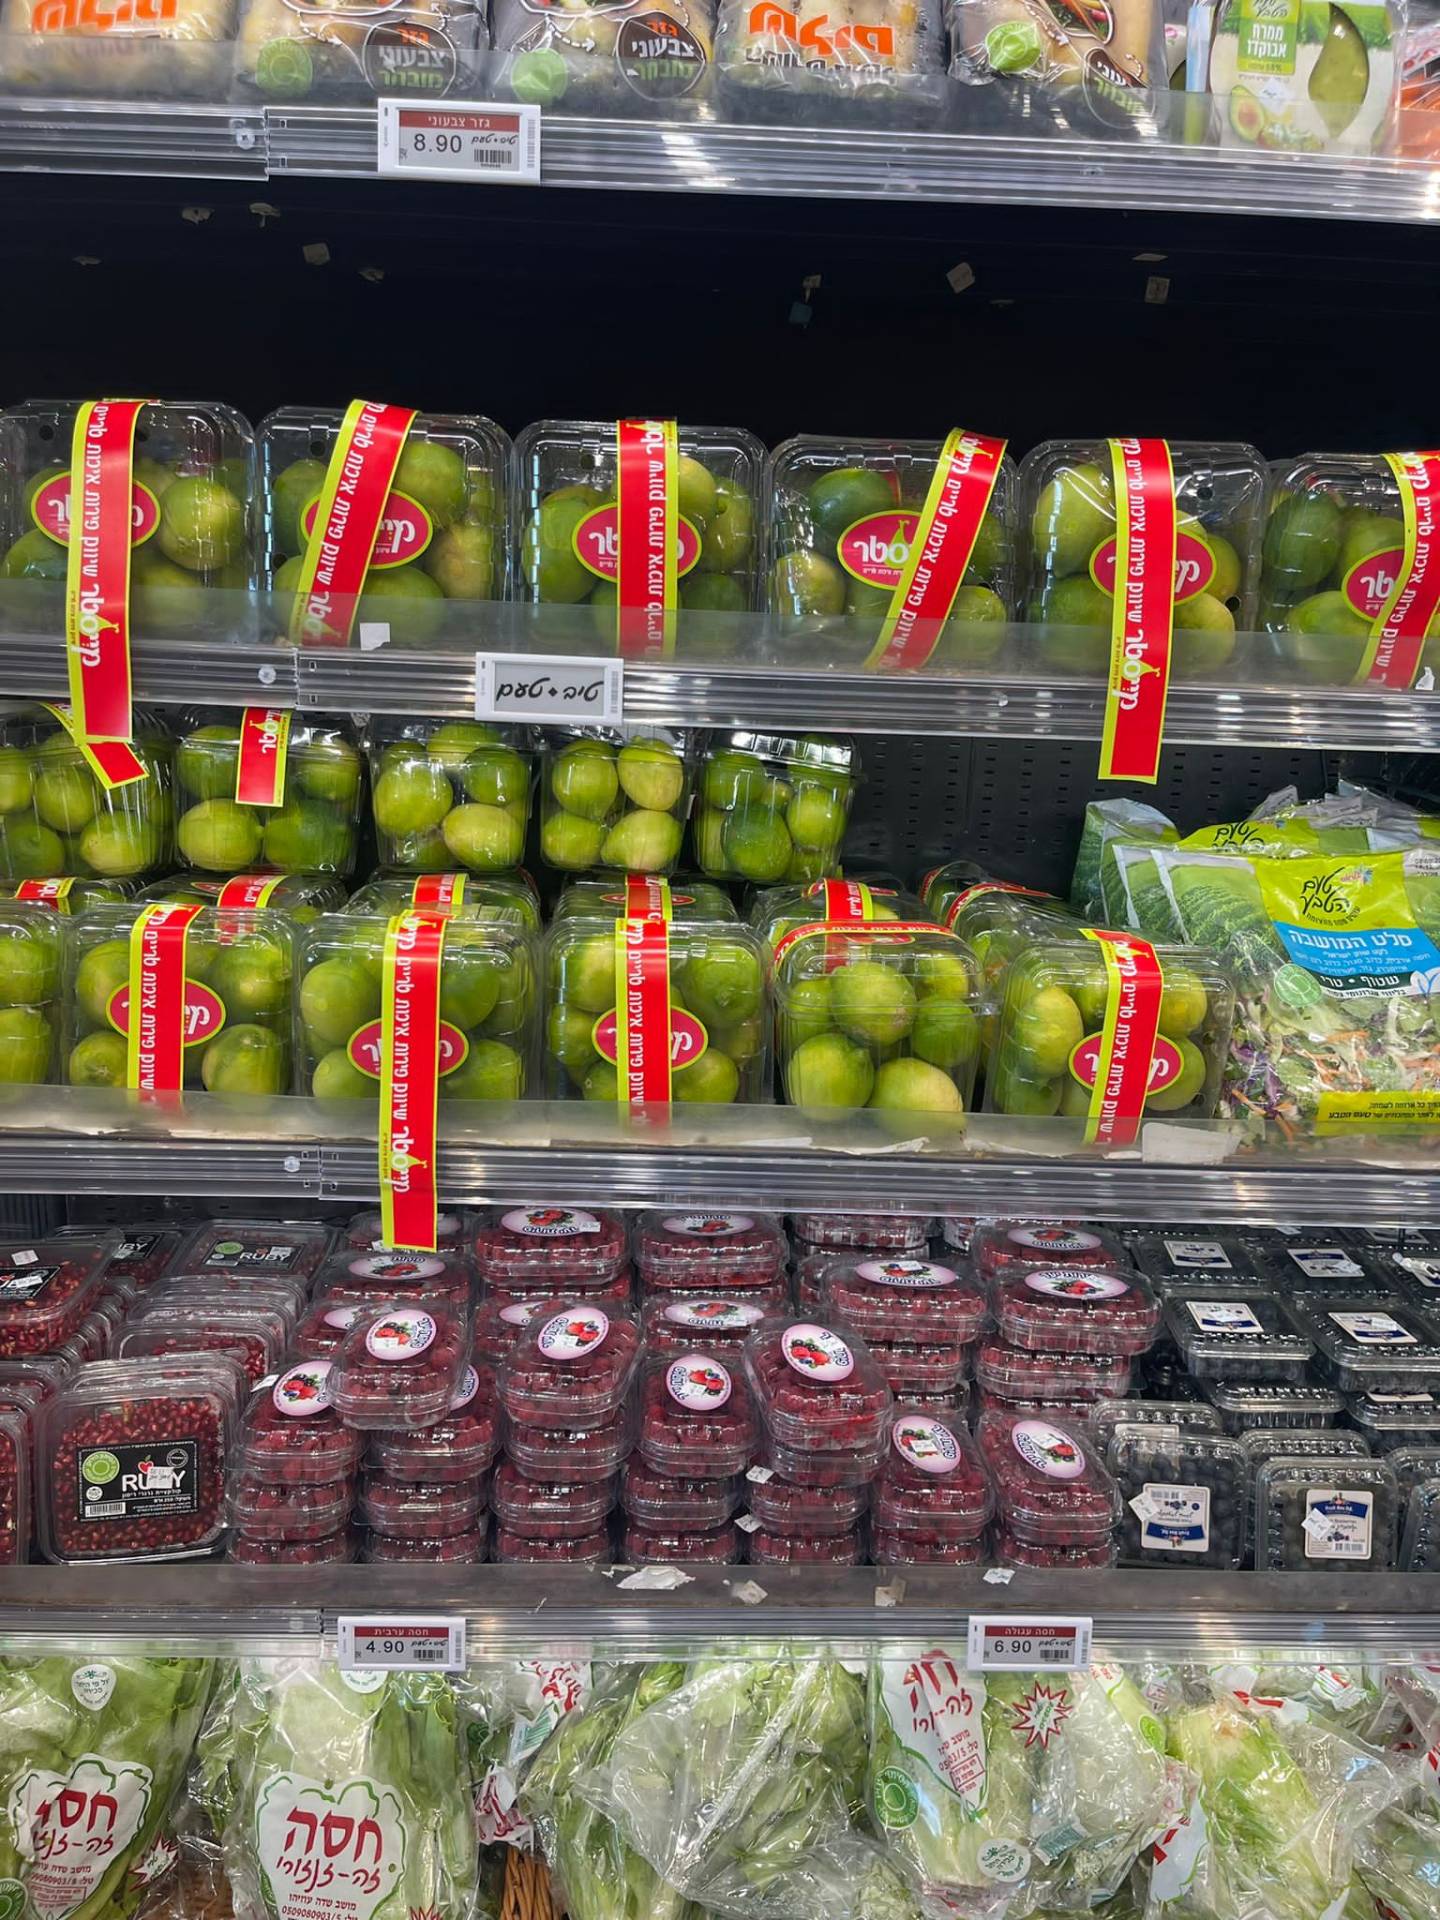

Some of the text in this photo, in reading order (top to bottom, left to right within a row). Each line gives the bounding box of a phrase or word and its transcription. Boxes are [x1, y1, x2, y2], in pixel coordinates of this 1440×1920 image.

[631, 37, 695, 58] צבעוני
[1247, 39, 1288, 58] אבוקדו
[427, 115, 491, 128] גזר צבעוני
[413, 133, 463, 153] 8.90
[88, 403, 109, 440] טריים
[353, 414, 377, 449] טריים
[85, 443, 102, 486] איכות
[339, 450, 365, 495] איכות
[648, 459, 669, 501] שיווק
[1129, 459, 1149, 490] טריים
[83, 490, 101, 531] פירות
[938, 478, 962, 518] טריים
[1128, 492, 1147, 534] איכות
[1416, 495, 1436, 537] טריים
[328, 496, 352, 540] פירות
[648, 506, 665, 549] פירות
[79, 537, 100, 582] שיווק
[928, 522, 949, 564] איכות
[1129, 538, 1146, 579] פירות
[317, 540, 341, 586] שיווק
[647, 553, 664, 596] איכות
[1409, 541, 1430, 585] איכות
[907, 565, 933, 607] פירות
[1125, 582, 1144, 624] שיווק
[1389, 587, 1417, 624] פירות
[495, 677, 605, 702] טיב טעם
[1302, 866, 1345, 895] טעם
[1300, 886, 1351, 915] הטבע
[142, 930, 162, 966] טריים
[1288, 929, 1413, 949] סלט המושבה
[396, 954, 413, 993] טריים
[629, 950, 646, 986] טריים
[1319, 975, 1401, 988] שטוף טרי
[141, 970, 158, 1010] איכות
[1119, 983, 1137, 1019] טריים
[395, 997, 412, 1037] איכות
[628, 990, 644, 1028] איכות
[141, 1011, 156, 1050] פירות
[1112, 1022, 1132, 1059] איכות
[394, 1038, 411, 1079] פירות
[629, 1031, 644, 1068] פירות
[137, 1053, 155, 1090] שיווק
[625, 1072, 645, 1107] שיווק
[1106, 1063, 1125, 1097] פירות
[389, 1082, 409, 1121] שיווק
[1099, 1099, 1118, 1134] שיווק
[240, 1252, 289, 1261] RUBY
[122, 1470, 186, 1492] RUY
[365, 1640, 405, 1654] 4.90
[374, 1629, 405, 1637] ערבית
[994, 1640, 1032, 1654] 6.90
[1004, 1628, 1056, 1636] חסה עגולה
[284, 1805, 383, 1865] חסה
[288, 1893, 357, 1911] מושב שדה עוזיהו
